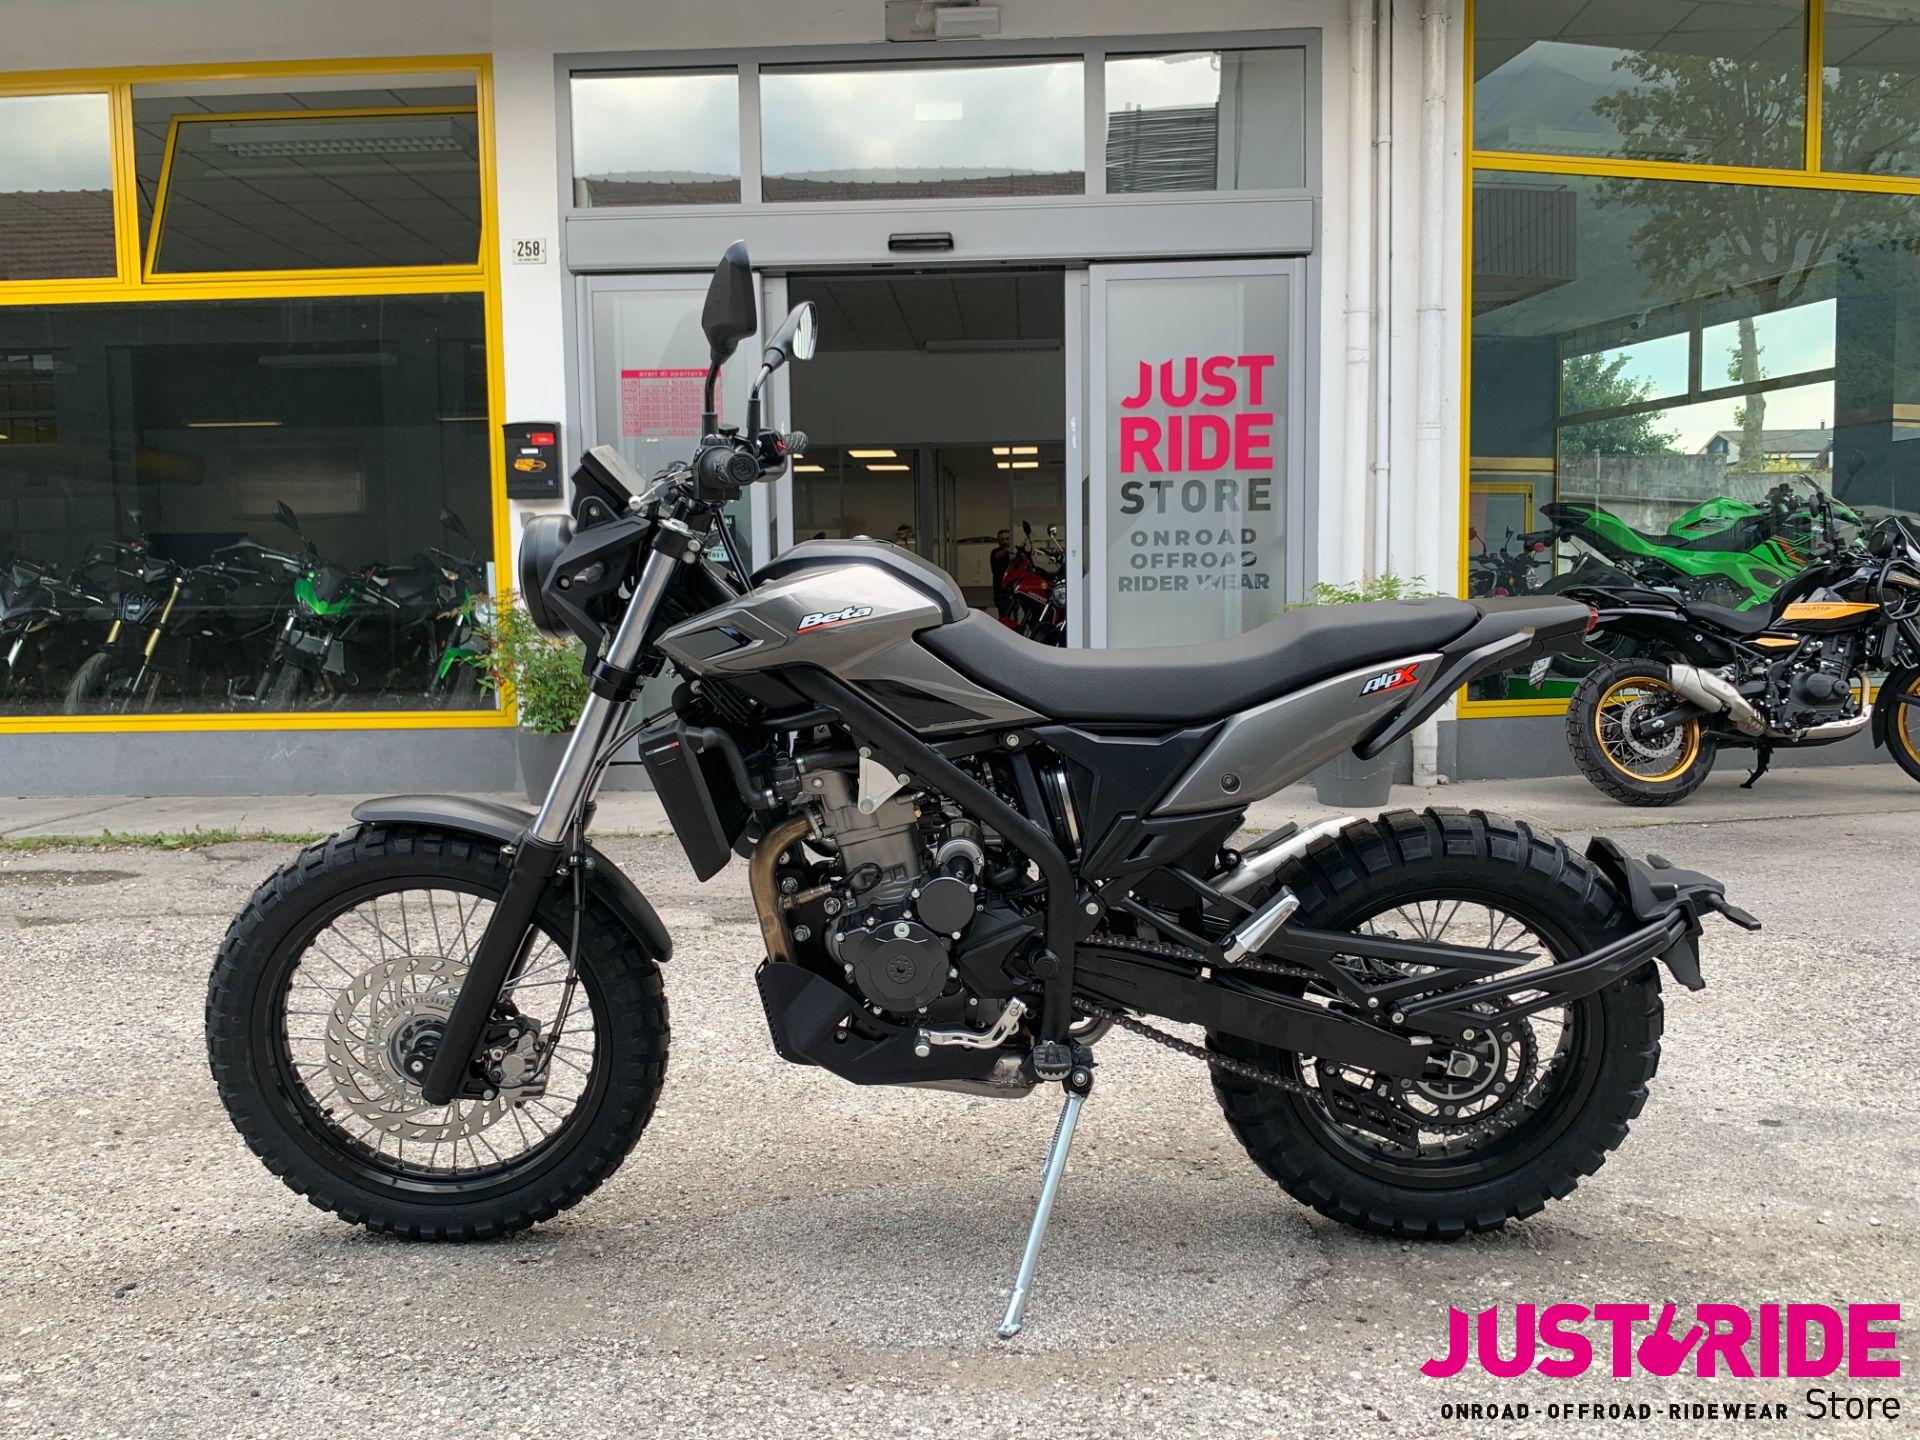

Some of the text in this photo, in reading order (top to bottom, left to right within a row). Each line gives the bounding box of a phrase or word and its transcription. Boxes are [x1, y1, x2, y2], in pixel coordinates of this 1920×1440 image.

[517, 240, 540, 257] 258
[1121, 355, 1275, 409] JUST
[1120, 413, 1275, 473] RIDE
[1120, 477, 1272, 515] STORE
[1130, 527, 1257, 548] ONROAD
[1130, 550, 1257, 570] OFFROAD
[1118, 572, 1271, 593] RIDER WEAR
[797, 606, 873, 630] Beta
